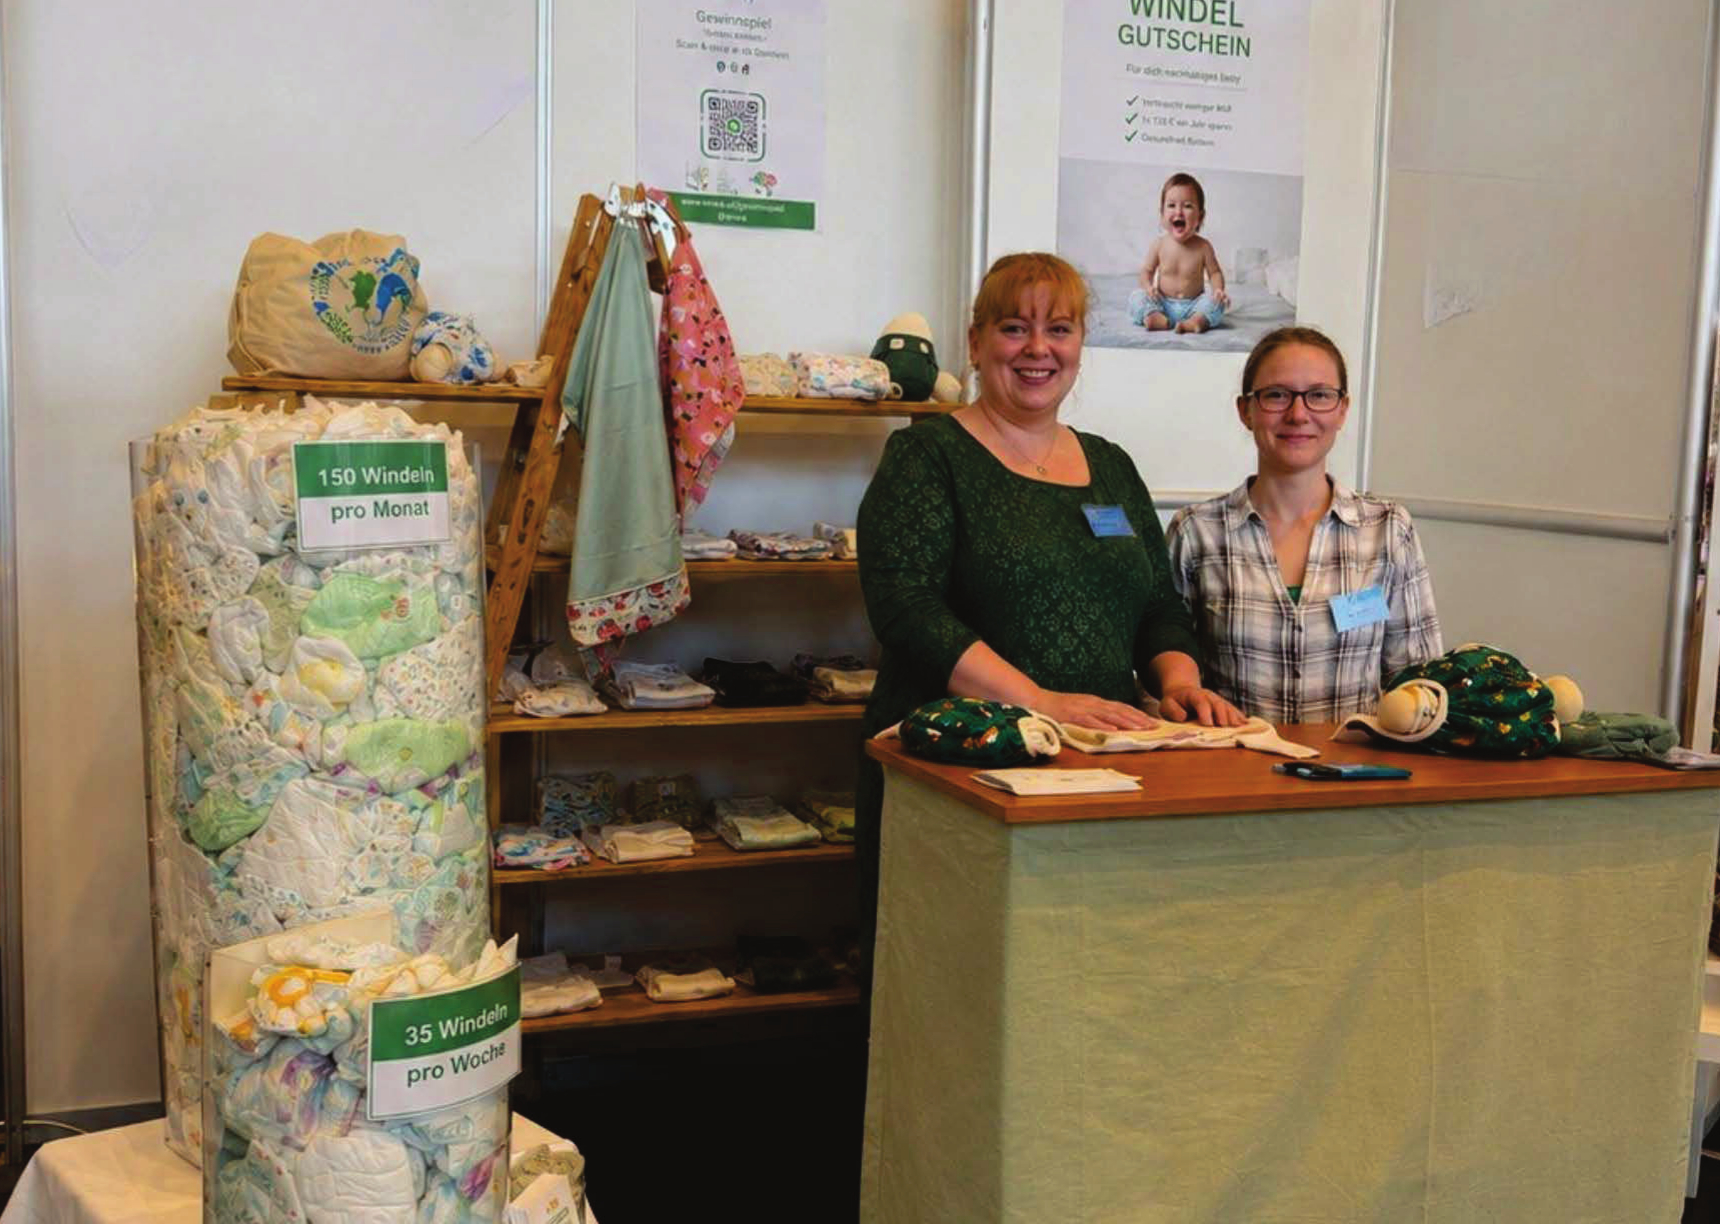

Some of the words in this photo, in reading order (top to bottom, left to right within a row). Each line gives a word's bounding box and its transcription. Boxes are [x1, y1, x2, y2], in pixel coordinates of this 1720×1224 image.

[695, 10, 772, 30] Gewinnspiel
[1130, 0, 1244, 28] WINDEL
[1118, 23, 1251, 58] GUTSCHEIN
[318, 468, 357, 487] 150
[361, 465, 435, 485] Windeln
[331, 504, 366, 524] pro
[373, 500, 429, 518] Monat
[404, 1024, 433, 1046] 35
[438, 1003, 508, 1040] Windeln
[407, 1065, 444, 1088] pro
[450, 1042, 506, 1074] Woche
